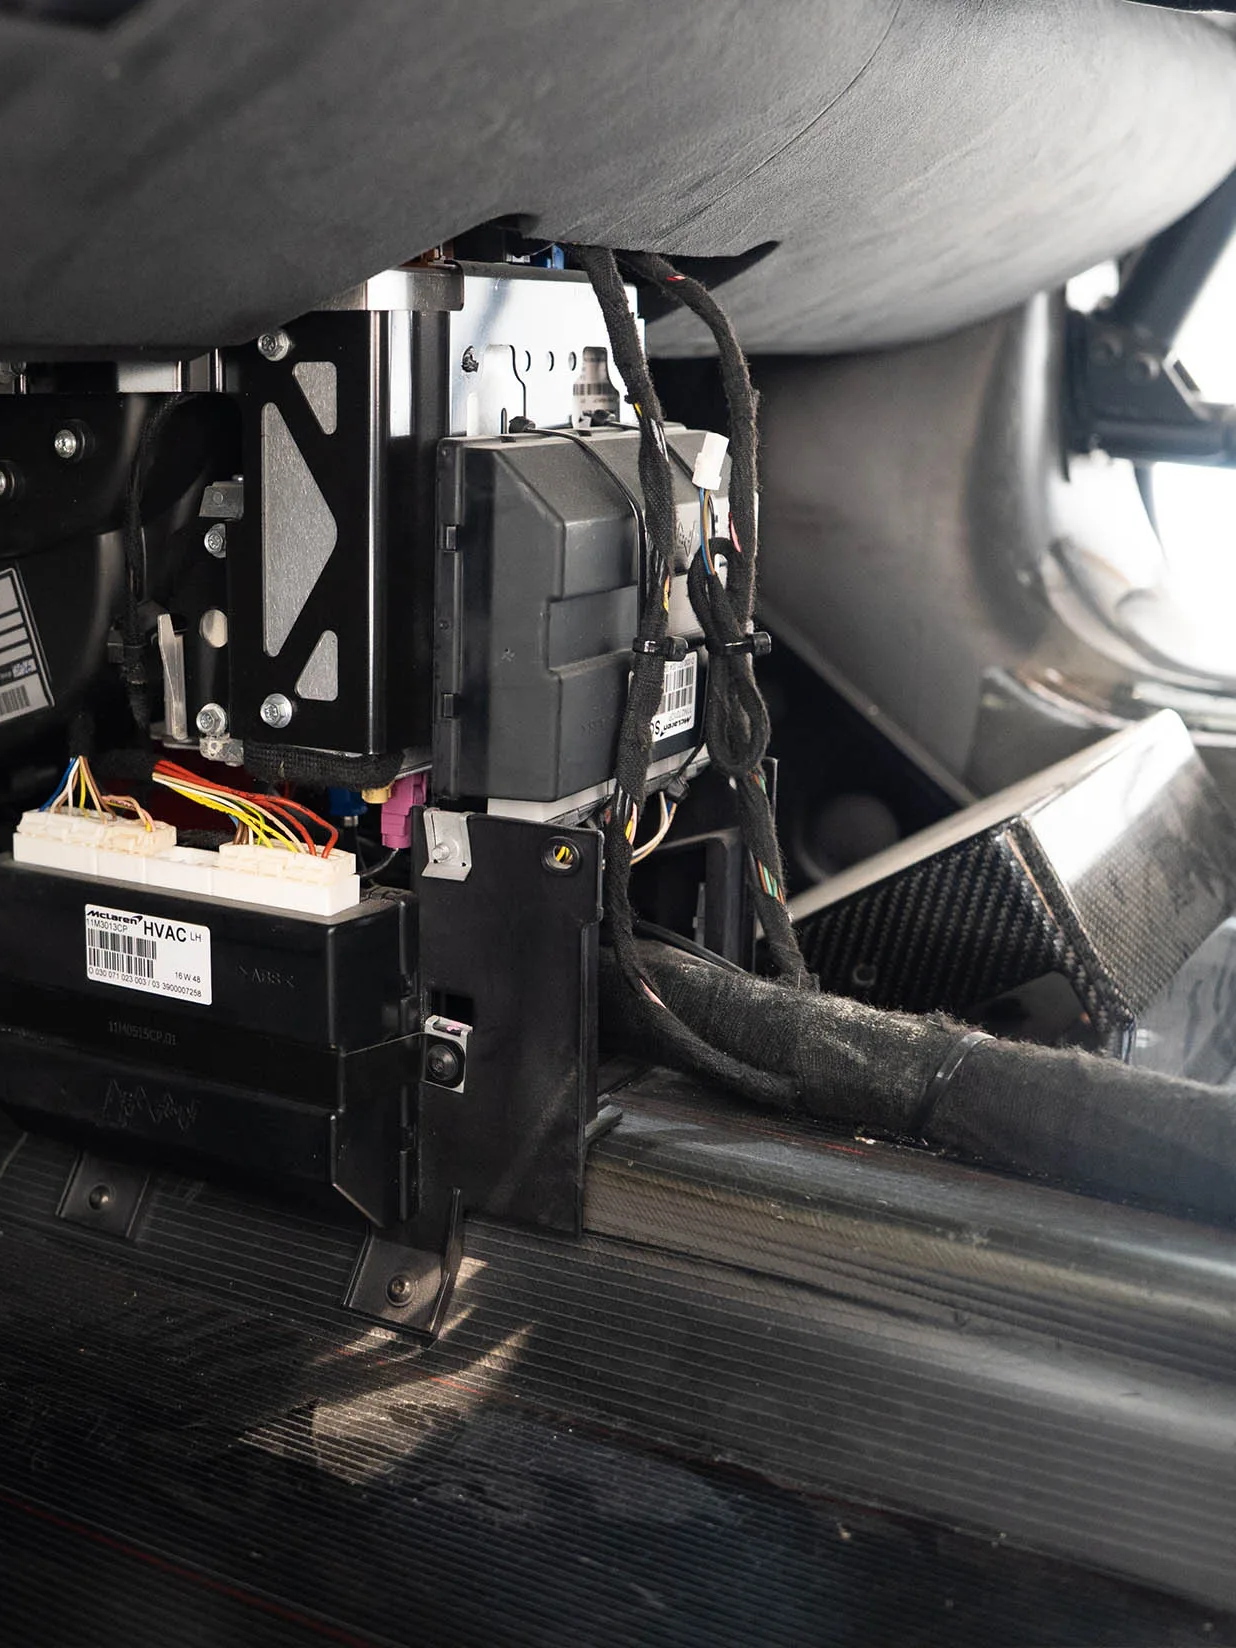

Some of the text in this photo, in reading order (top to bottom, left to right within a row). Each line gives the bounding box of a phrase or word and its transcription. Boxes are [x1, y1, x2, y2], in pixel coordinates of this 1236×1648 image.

[664, 716, 692, 730] McLaren
[87, 918, 128, 933] 11M3013CP
[87, 910, 202, 942] McLaren HVAC LH
[95, 968, 107, 977] 030
[108, 971, 119, 980] 071
[121, 973, 133, 983] 023
[135, 975, 147, 986] 003
[152, 980, 160, 989] 03
[174, 971, 201, 984] 16 W 48
